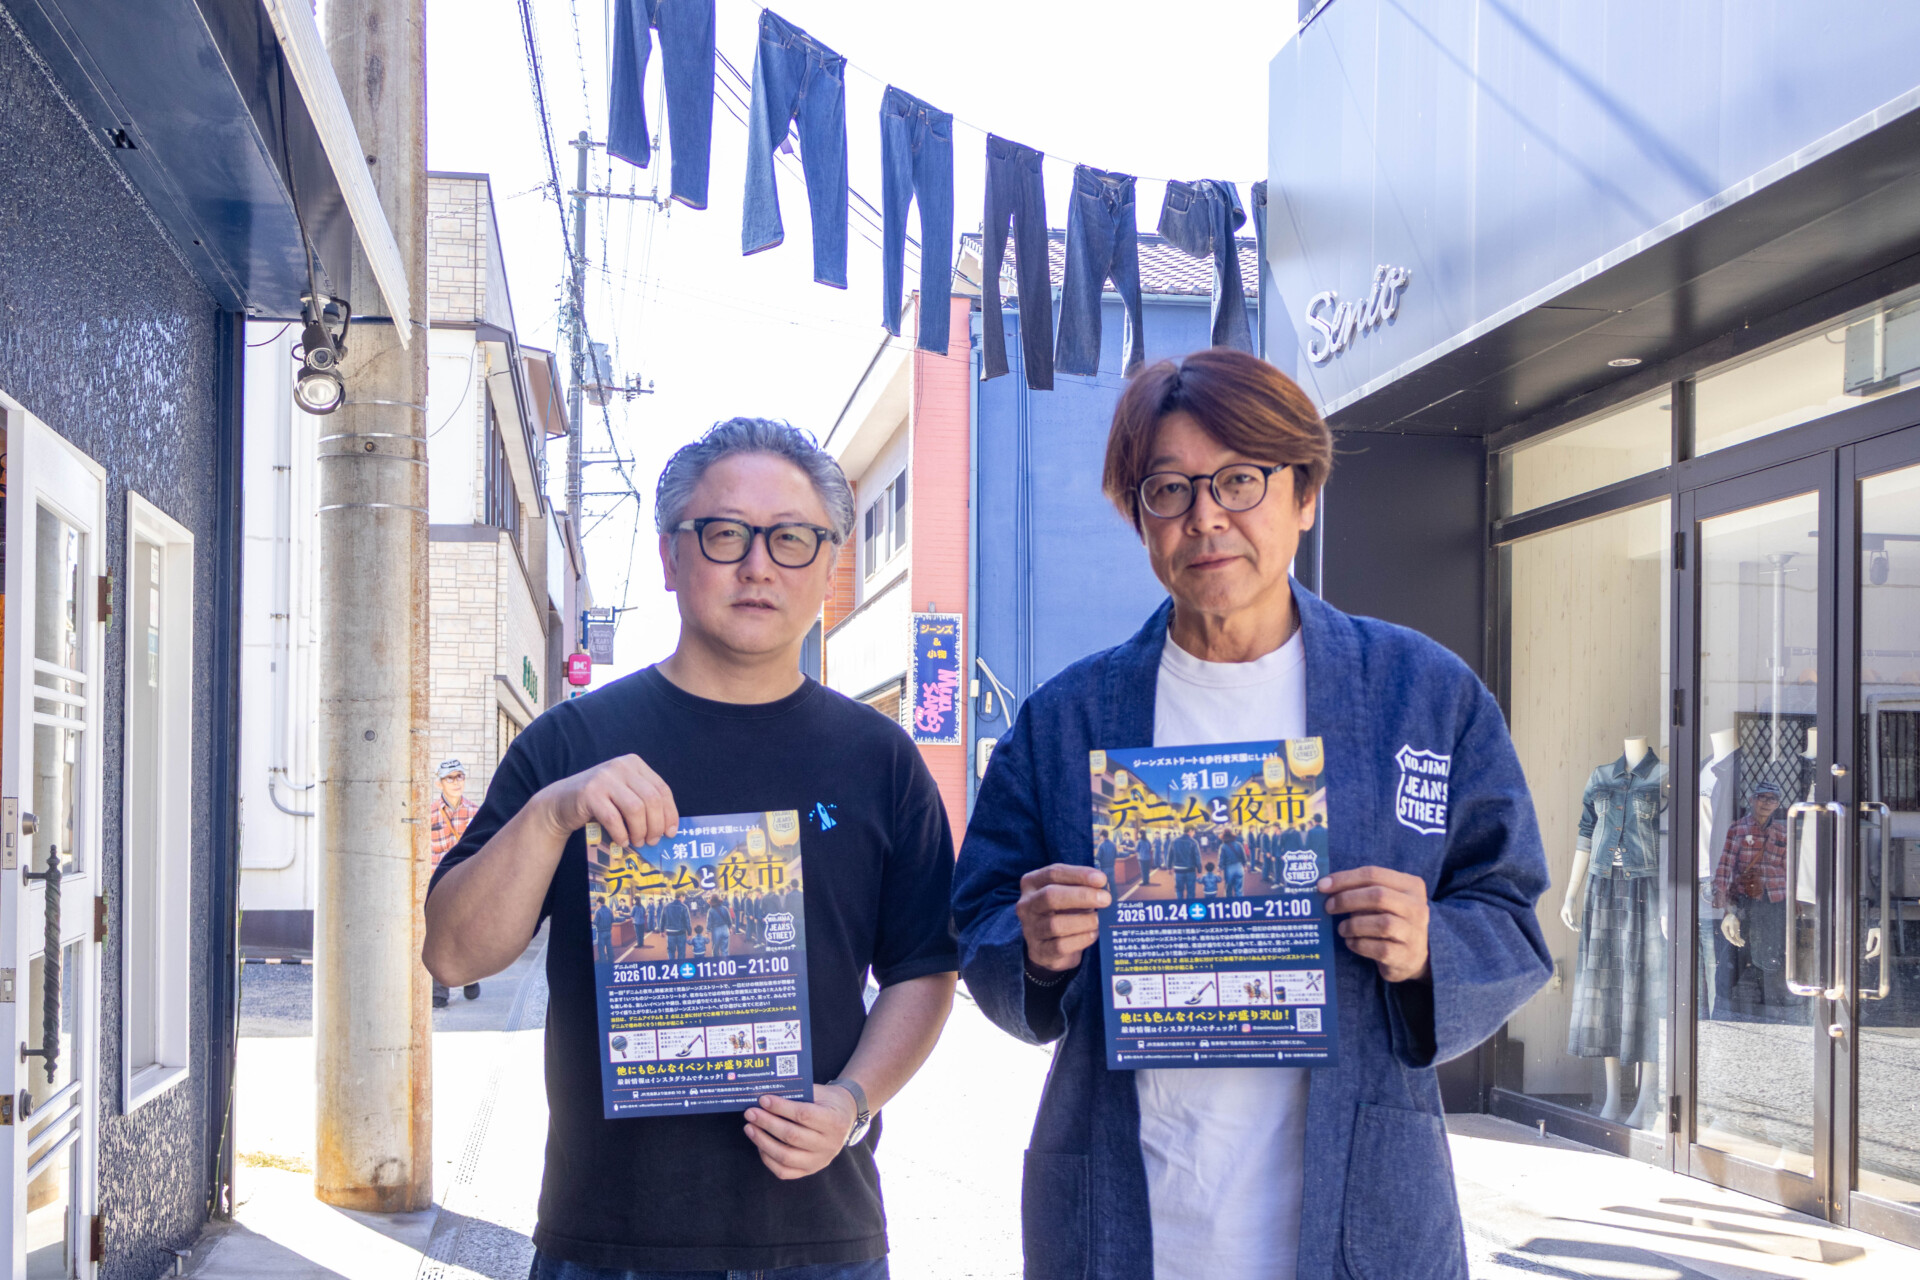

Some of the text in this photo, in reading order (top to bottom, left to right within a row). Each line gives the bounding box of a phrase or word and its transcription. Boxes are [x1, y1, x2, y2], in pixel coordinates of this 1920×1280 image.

[920, 624, 953, 634] ジーンズ
[932, 637, 942, 647] &
[927, 650, 947, 659] 小物
[573, 661, 588, 670] DC
[1404, 753, 1447, 777] KOJIM
[1180, 769, 1228, 791] 第1回
[1405, 775, 1448, 802] JEANS
[1107, 786, 1310, 831] デニムと夜市
[1400, 796, 1447, 825] STREE
[676, 823, 760, 836] ートを歩行者天国にしよう!
[672, 840, 716, 860] 第1回
[604, 856, 788, 897] デニムと夜市
[1287, 870, 1315, 880] STREET
[1117, 909, 1146, 923] 2026
[1146, 904, 1189, 922] 10.24
[1190, 904, 1205, 917] 土
[768, 931, 793, 940] STREET
[613, 970, 640, 983] 2026
[641, 964, 679, 981] 10.24
[682, 964, 694, 976] 土
[1120, 1009, 1290, 1024] 他にも色んなイベントが盛り沢山!
[616, 1057, 771, 1076] 他にも色んなイベントが盛り沢山!
